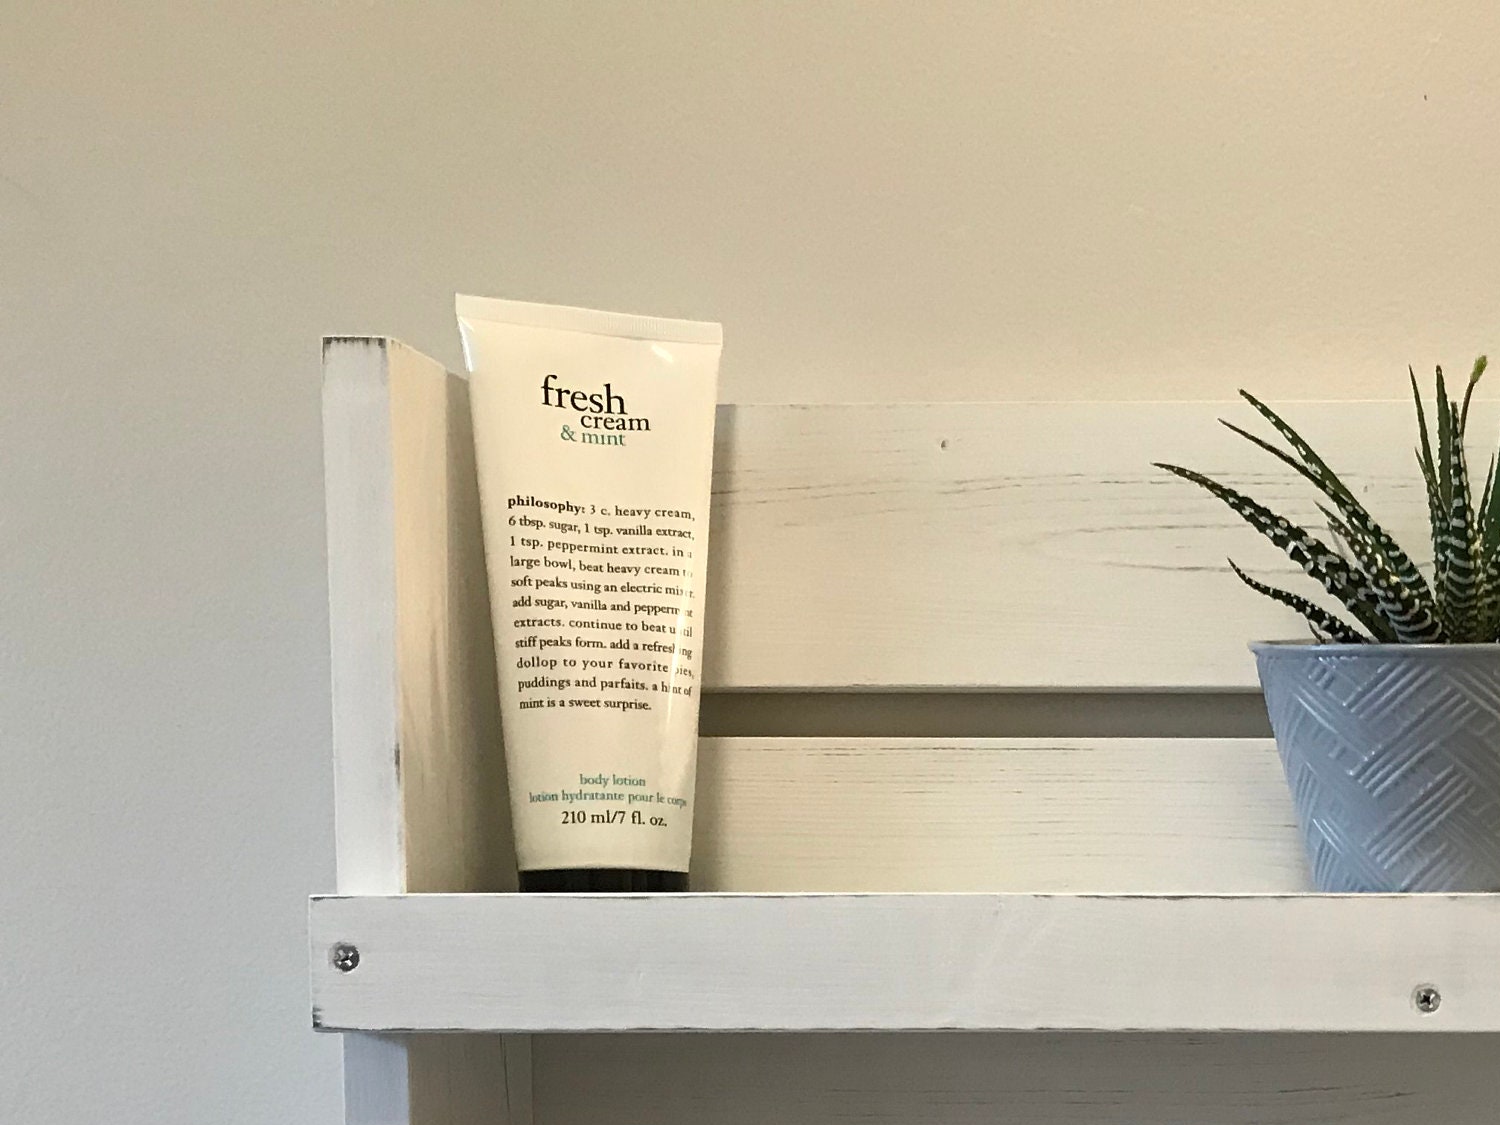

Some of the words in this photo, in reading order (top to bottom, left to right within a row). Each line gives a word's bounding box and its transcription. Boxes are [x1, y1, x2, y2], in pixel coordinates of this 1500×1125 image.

[541, 374, 628, 415] fresh
[580, 415, 651, 431] cream
[560, 424, 577, 442] &
[581, 432, 627, 446] mint
[507, 494, 585, 516] philosophy:
[589, 504, 596, 514] 3
[600, 508, 611, 516] c.
[614, 505, 651, 519] heavy
[654, 509, 695, 521] cream,
[508, 515, 516, 526] 6
[519, 515, 546, 530] tbsp.
[548, 521, 581, 534] sugar,
[584, 523, 590, 533] 1
[594, 525, 613, 537] tsp.
[616, 525, 652, 536] vanilla
[655, 528, 694, 540] extract,
[510, 536, 515, 546] 1
[520, 537, 543, 550] tsp.
[547, 540, 618, 554] peppermint
[622, 546, 668, 555] extract.
[672, 546, 684, 557] in
[510, 555, 541, 570] large
[544, 556, 576, 572] bowl,
[579, 560, 604, 573] beat
[607, 562, 641, 576] heavy
[644, 565, 680, 576] cream
[511, 575, 533, 587] soft
[535, 576, 568, 589] peaks
[570, 580, 601, 594] using
[603, 584, 618, 592] an
[620, 582, 663, 594] electric
[512, 595, 532, 608] add
[535, 599, 568, 610] sugar,
[571, 599, 607, 611] vanilla
[610, 601, 630, 611] and
[513, 618, 565, 628] extracts.
[568, 618, 622, 630] continue
[625, 623, 638, 631] to
[641, 620, 666, 633] beat
[669, 626, 692, 638] util
[515, 635, 537, 649] stiff
[539, 635, 572, 650] peaks
[575, 636, 607, 649] form.
[609, 639, 630, 650] add
[516, 656, 557, 670] dollop
[563, 658, 577, 667] to
[582, 660, 613, 670] your
[618, 658, 669, 672] favorite
[518, 676, 571, 692] puddings
[574, 676, 597, 688] and
[600, 677, 648, 691] parfaits.
[652, 683, 658, 691] a
[683, 686, 692, 696] of
[519, 697, 544, 709] mint
[547, 696, 556, 707] is
[559, 699, 565, 707] a
[568, 699, 601, 708] sweet
[603, 699, 652, 711] surprise.
[579, 773, 609, 788] body
[612, 774, 646, 787] lotion
[528, 791, 559, 803] lotion
[561, 789, 625, 803] hydratante
[628, 793, 654, 805] pour
[656, 792, 665, 804] le
[561, 810, 586, 824] 210
[590, 810, 626, 824] ml/7
[631, 810, 645, 825] fl.
[650, 816, 667, 827] oz.
